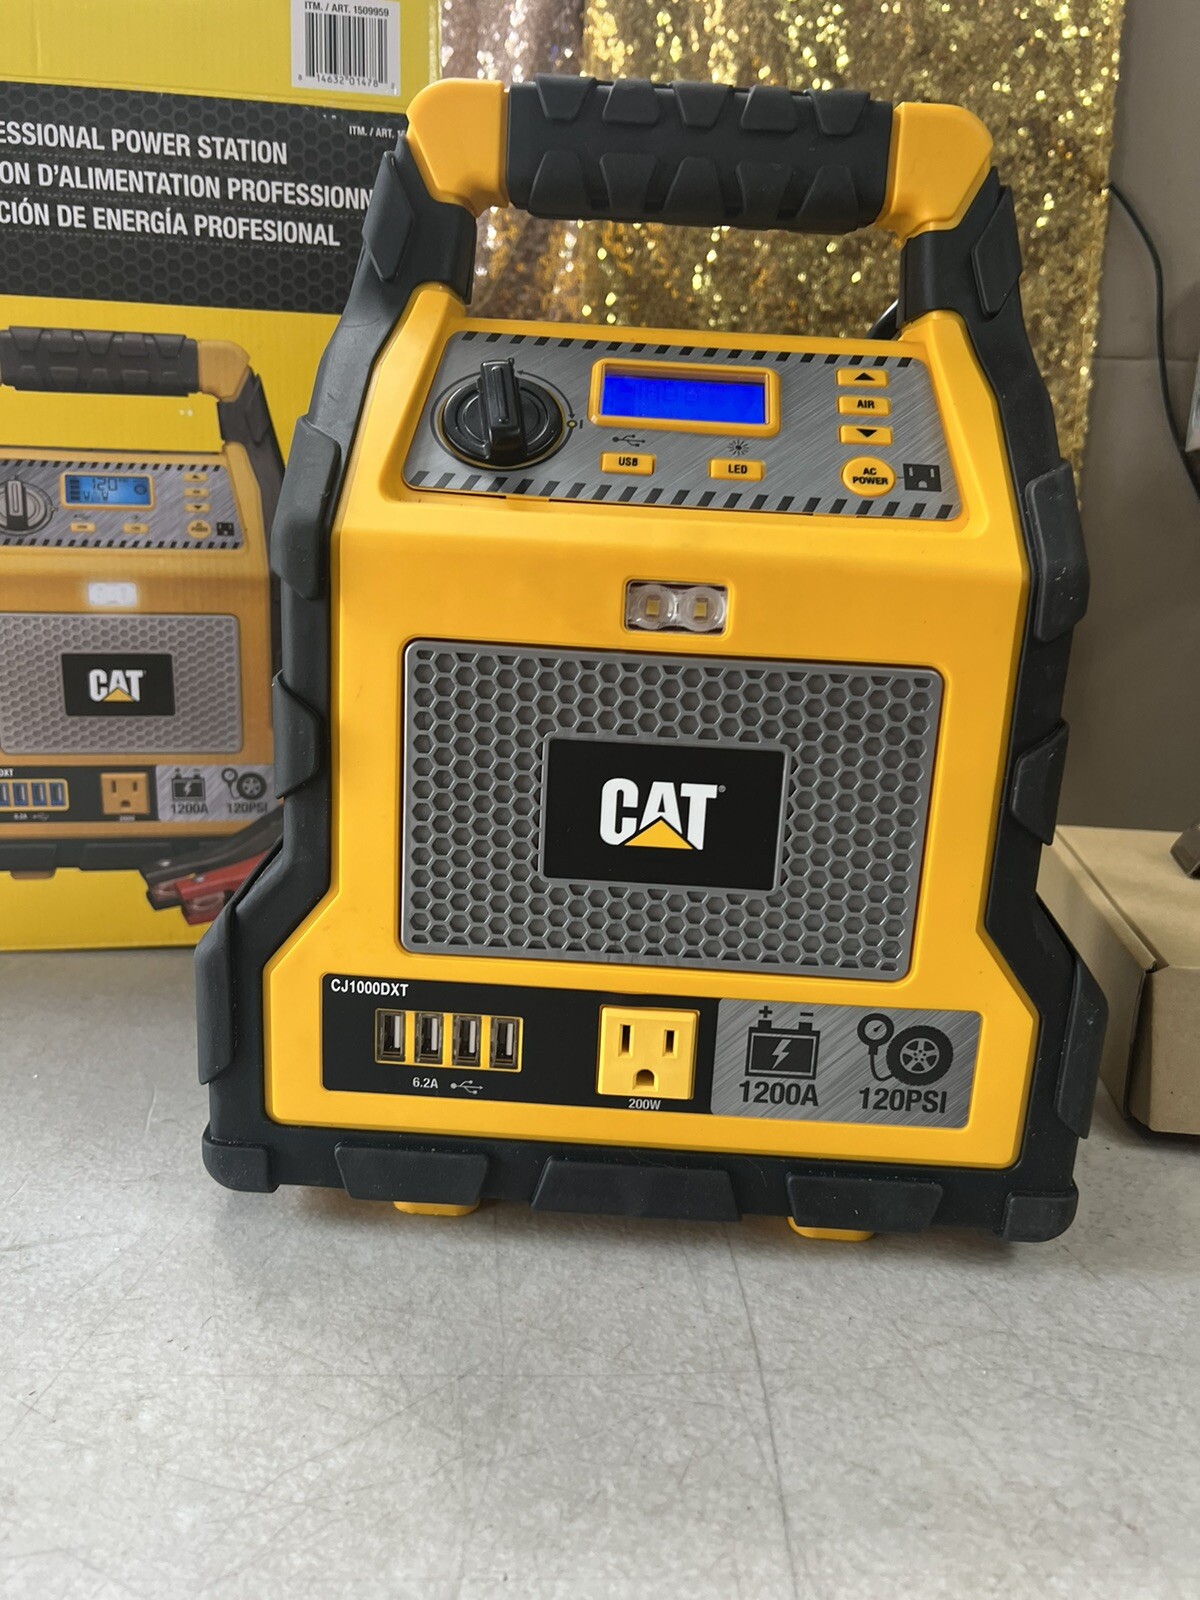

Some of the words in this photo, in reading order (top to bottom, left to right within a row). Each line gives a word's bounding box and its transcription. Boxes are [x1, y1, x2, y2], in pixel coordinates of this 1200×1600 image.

[304, 1, 323, 11] ITM.
[331, 4, 350, 14] ART.
[353, 5, 389, 17] 1509959
[316, 74, 344, 85] 14632
[349, 78, 379, 88] 01478
[348, 125, 367, 136] ITM.
[375, 127, 394, 139] ART.
[111, 128, 191, 157] POWER
[197, 135, 288, 165] STATION
[0, 160, 30, 185] ON
[0, 196, 50, 227] CIÓN
[56, 204, 87, 229] DE
[92, 206, 188, 236] ENERGÍA
[194, 214, 341, 247] PROFESIONAL
[856, 399, 876, 409] AIR
[618, 456, 638, 467] USB
[728, 464, 748, 475] LED
[863, 467, 877, 476] AC
[852, 476, 888, 485] POWER
[88, 669, 144, 702] CAT
[170, 803, 209, 815] 1200A
[226, 802, 268, 814] 120PSI
[599, 777, 718, 850] CAT
[330, 978, 409, 997] CJ1000DXT
[412, 1077, 439, 1089] 6.2A
[738, 1080, 819, 1107] 1200A
[858, 1086, 948, 1114] 120PSI
[628, 1098, 661, 1111] 200W
